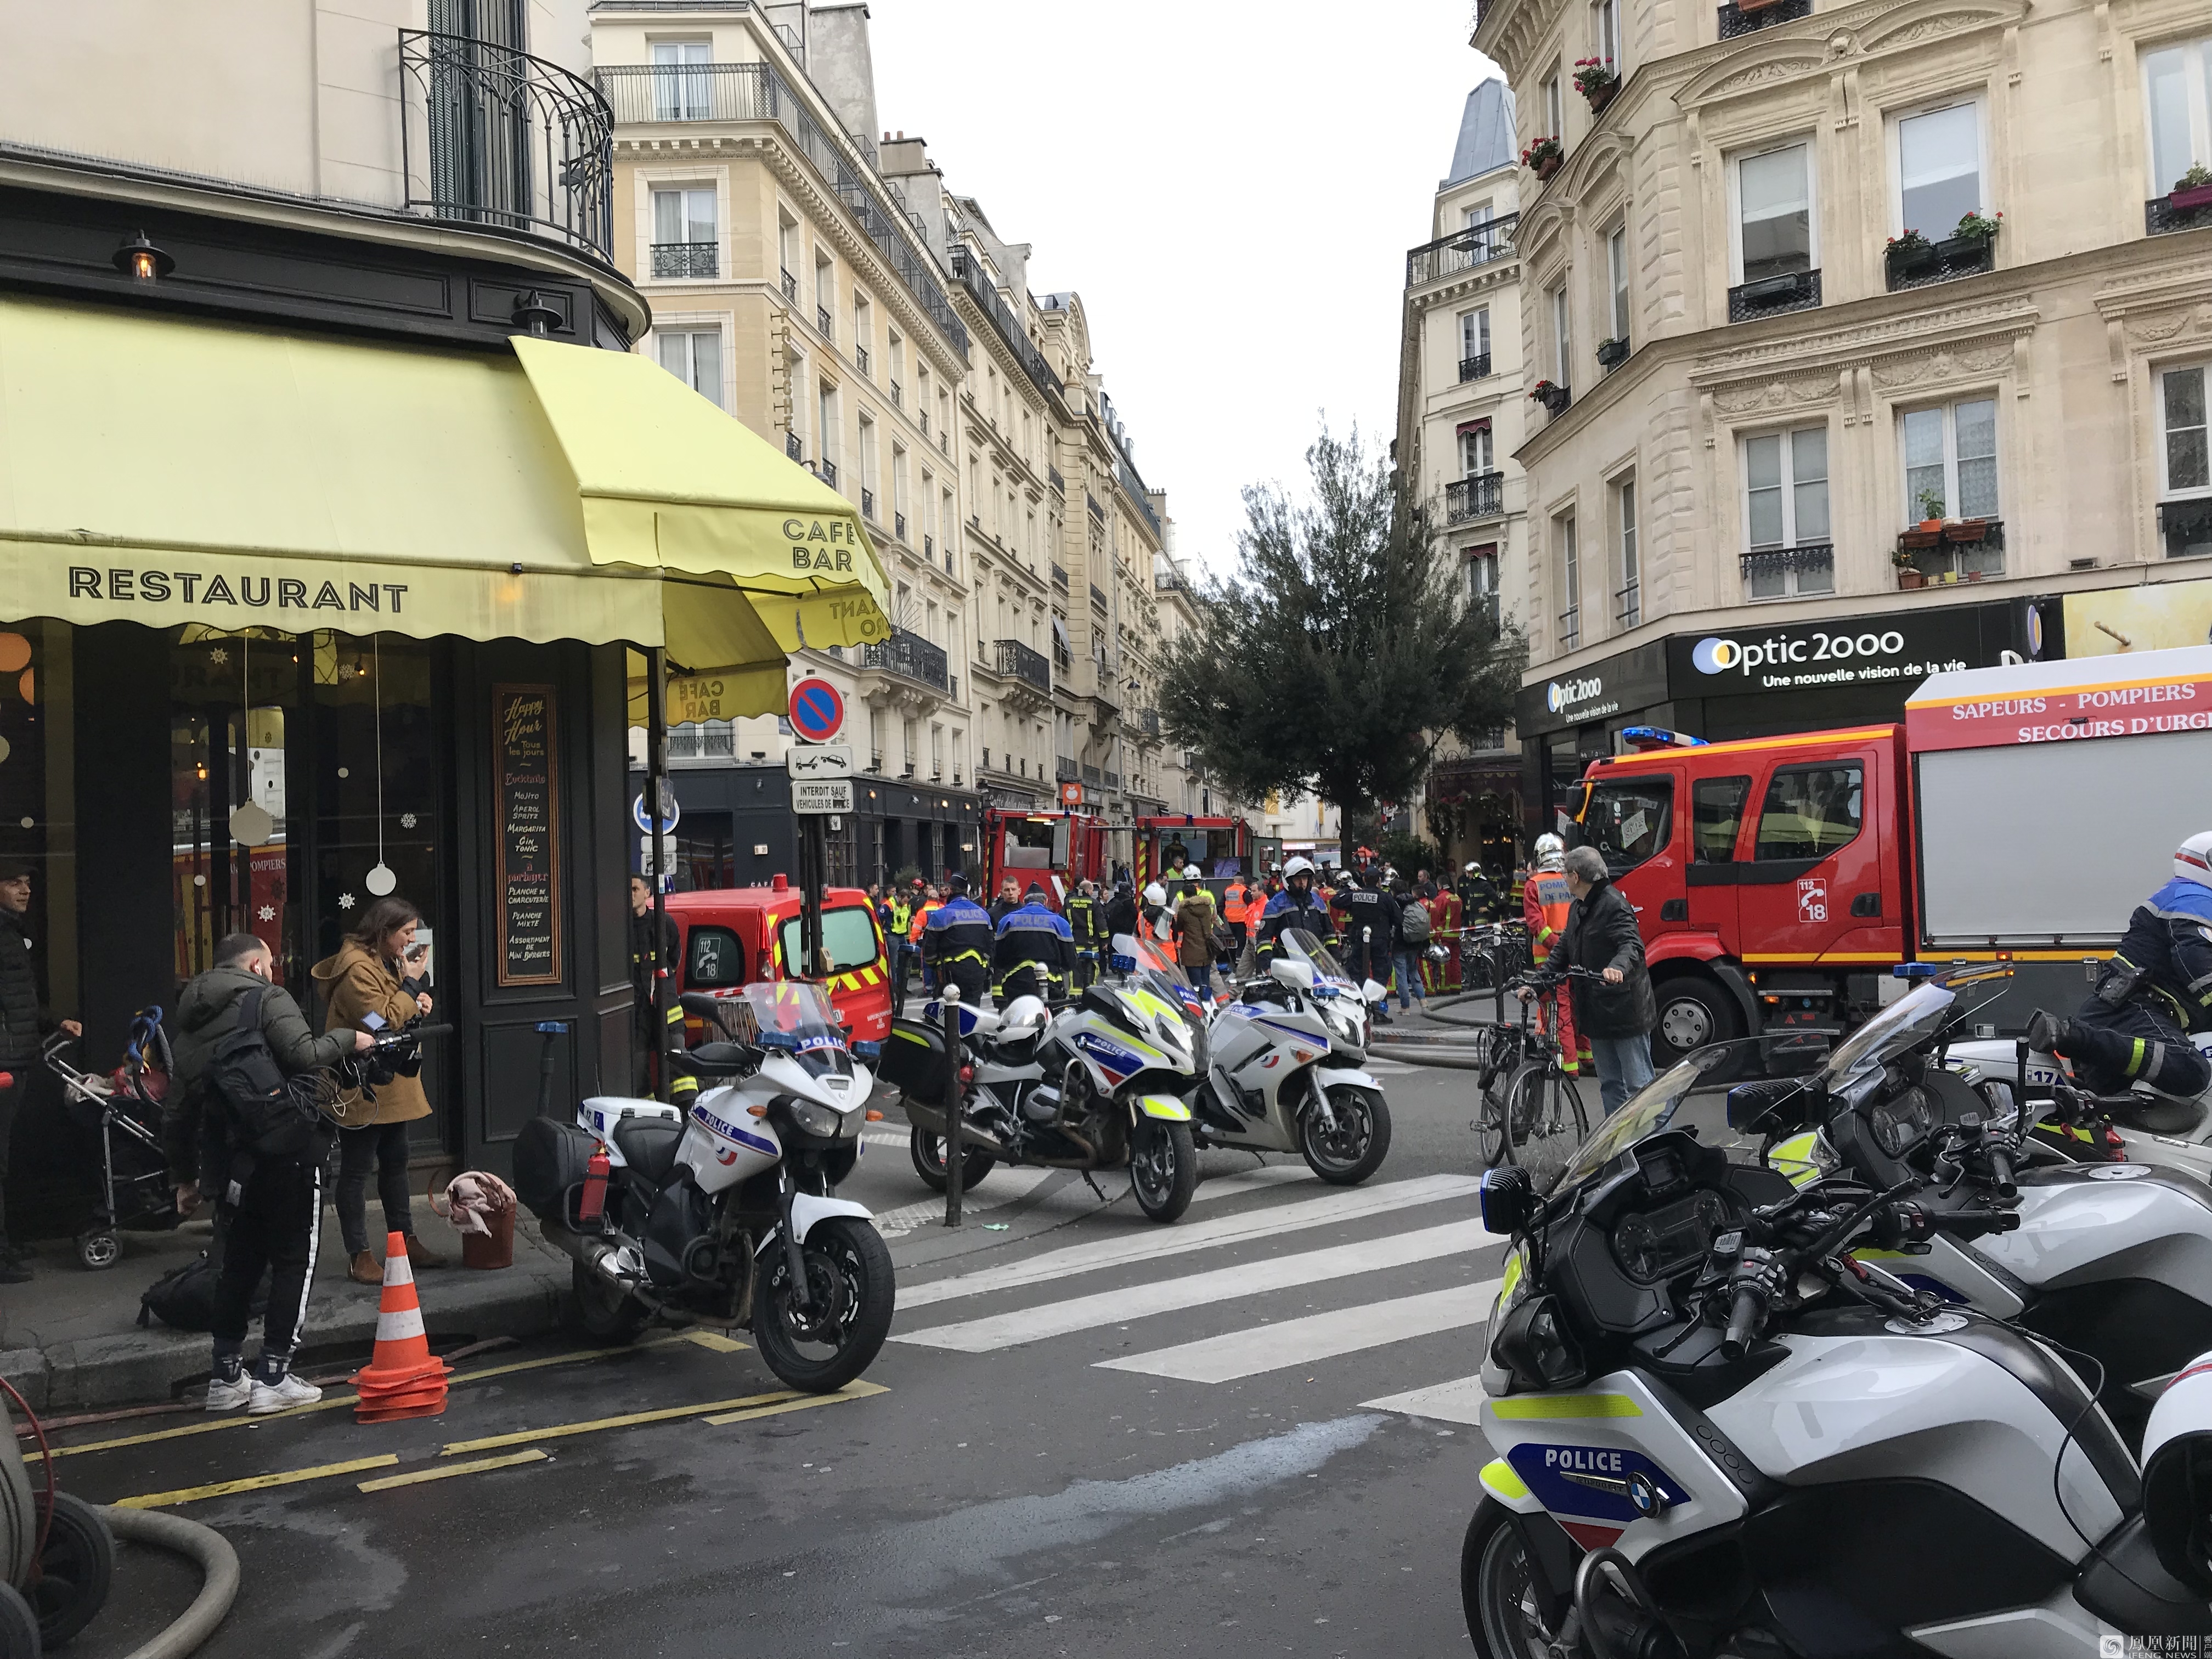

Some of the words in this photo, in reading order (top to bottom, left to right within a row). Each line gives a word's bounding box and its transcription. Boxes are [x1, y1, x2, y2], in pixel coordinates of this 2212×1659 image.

[793, 546, 853, 572] BAR
[69, 566, 408, 613] RESTAURANT
[1712, 634, 1807, 676] Optic
[1812, 631, 1904, 661] 2000
[1763, 675, 1790, 687] Une
[1795, 668, 1855, 685] nouvelle
[1859, 667, 1899, 679] vision
[1904, 662, 1923, 676] de
[1927, 661, 1939, 674] la
[1944, 659, 1967, 672] vie
[1953, 697, 2047, 720] SAPEURS
[2078, 683, 2196, 709] POMPIERS
[504, 696, 544, 723] Happy
[504, 719, 542, 745] Hour
[2018, 719, 2125, 743] SECOURS
[510, 746, 520, 755] les
[523, 748, 544, 759] jours
[800, 786, 829, 796] INTERDIT
[831, 786, 847, 796] SAUF
[797, 799, 823, 809] VEHICULES
[825, 799, 831, 809] DE
[507, 823, 546, 833] MARGARITA
[250, 857, 285, 873] OMPIERS
[508, 887, 538, 895] PLANCHE
[1799, 881, 1815, 890] 112
[1353, 893, 1376, 902] POLICE
[1544, 893, 1556, 901] DE
[512, 912, 543, 920] PLANCHE
[955, 910, 983, 919] POLICE
[1805, 904, 1826, 920] 18
[1014, 915, 1050, 926] POLICE
[701, 940, 711, 953] 112
[706, 963, 716, 977] 18
[800, 1036, 845, 1050] POLIC
[1094, 1038, 1127, 1058] POLICE
[2034, 1070, 2054, 1084] 17
[704, 1113, 734, 1136] POLICE
[1545, 1449, 1622, 1472] POLICE
